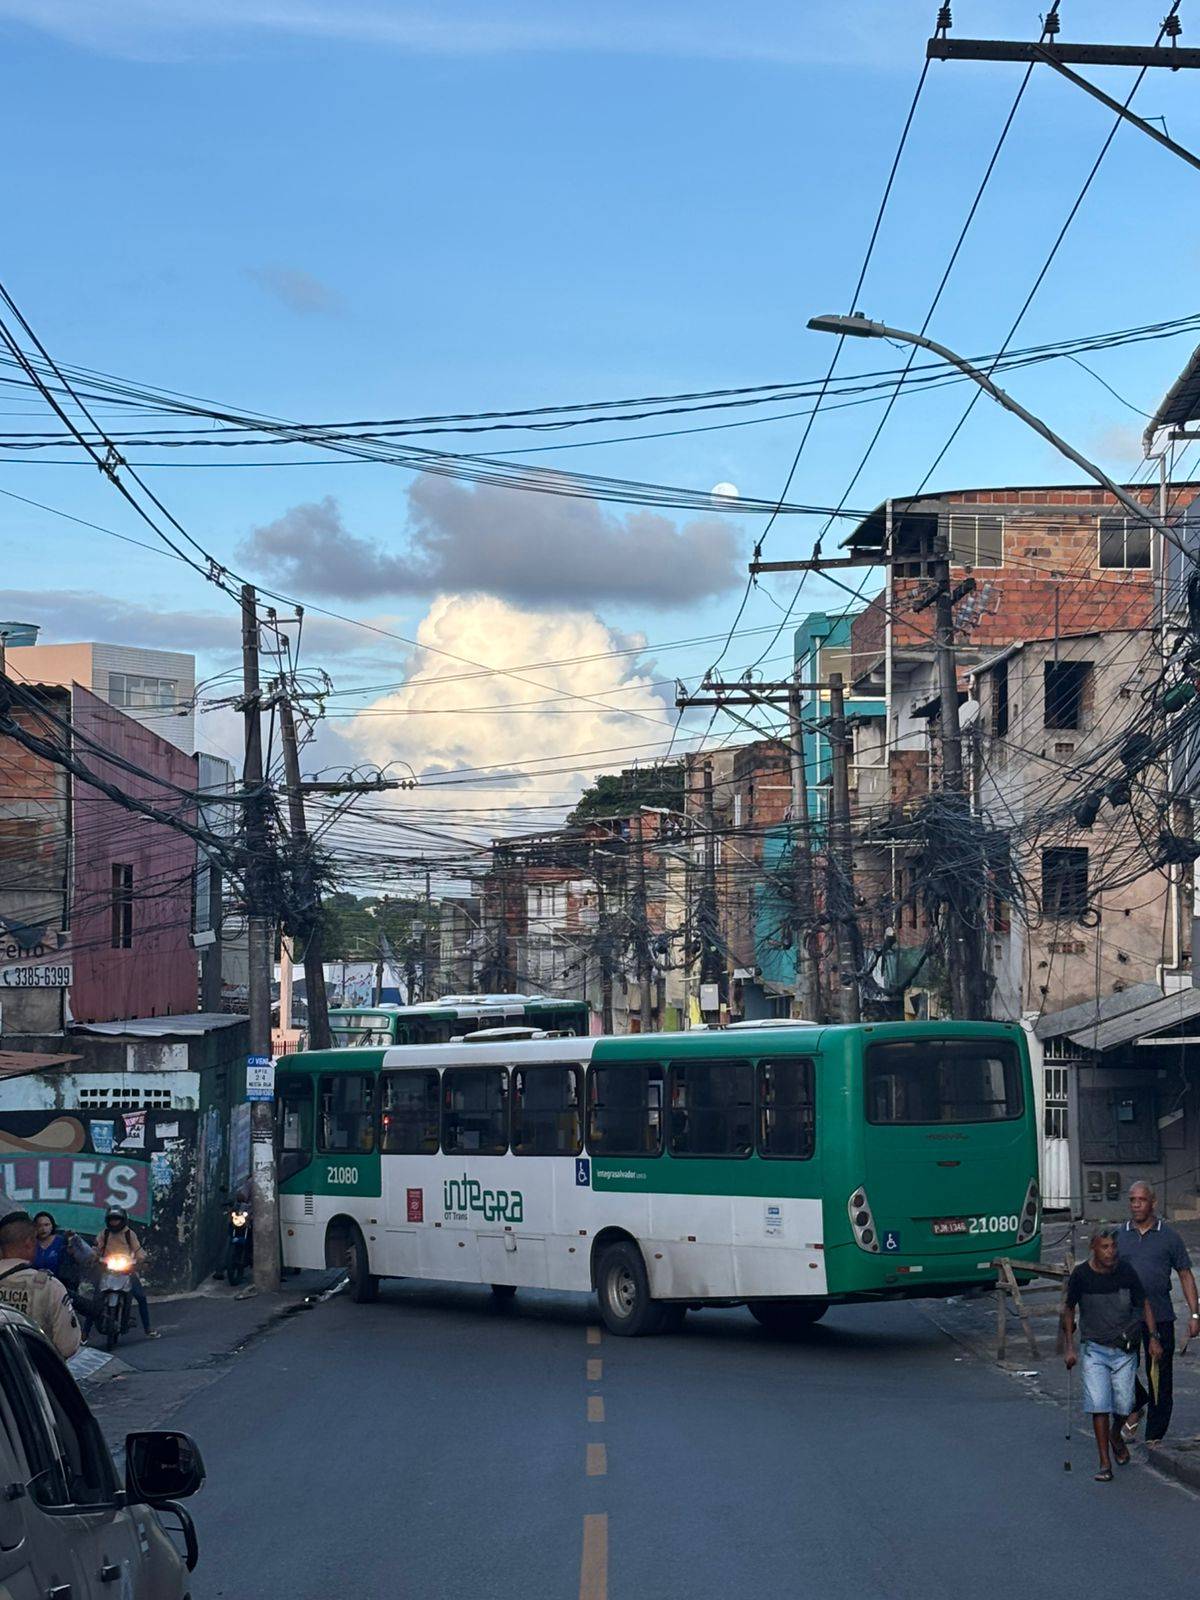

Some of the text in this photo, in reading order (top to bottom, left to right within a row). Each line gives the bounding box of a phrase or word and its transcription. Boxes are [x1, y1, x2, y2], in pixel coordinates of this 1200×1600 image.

[15, 967, 70, 985] 3385-6399
[327, 1166, 359, 1184] 21080
[0, 1160, 139, 1209] LLE'S
[444, 1212, 468, 1221] OT Trans
[968, 1215, 1019, 1234] 21080
